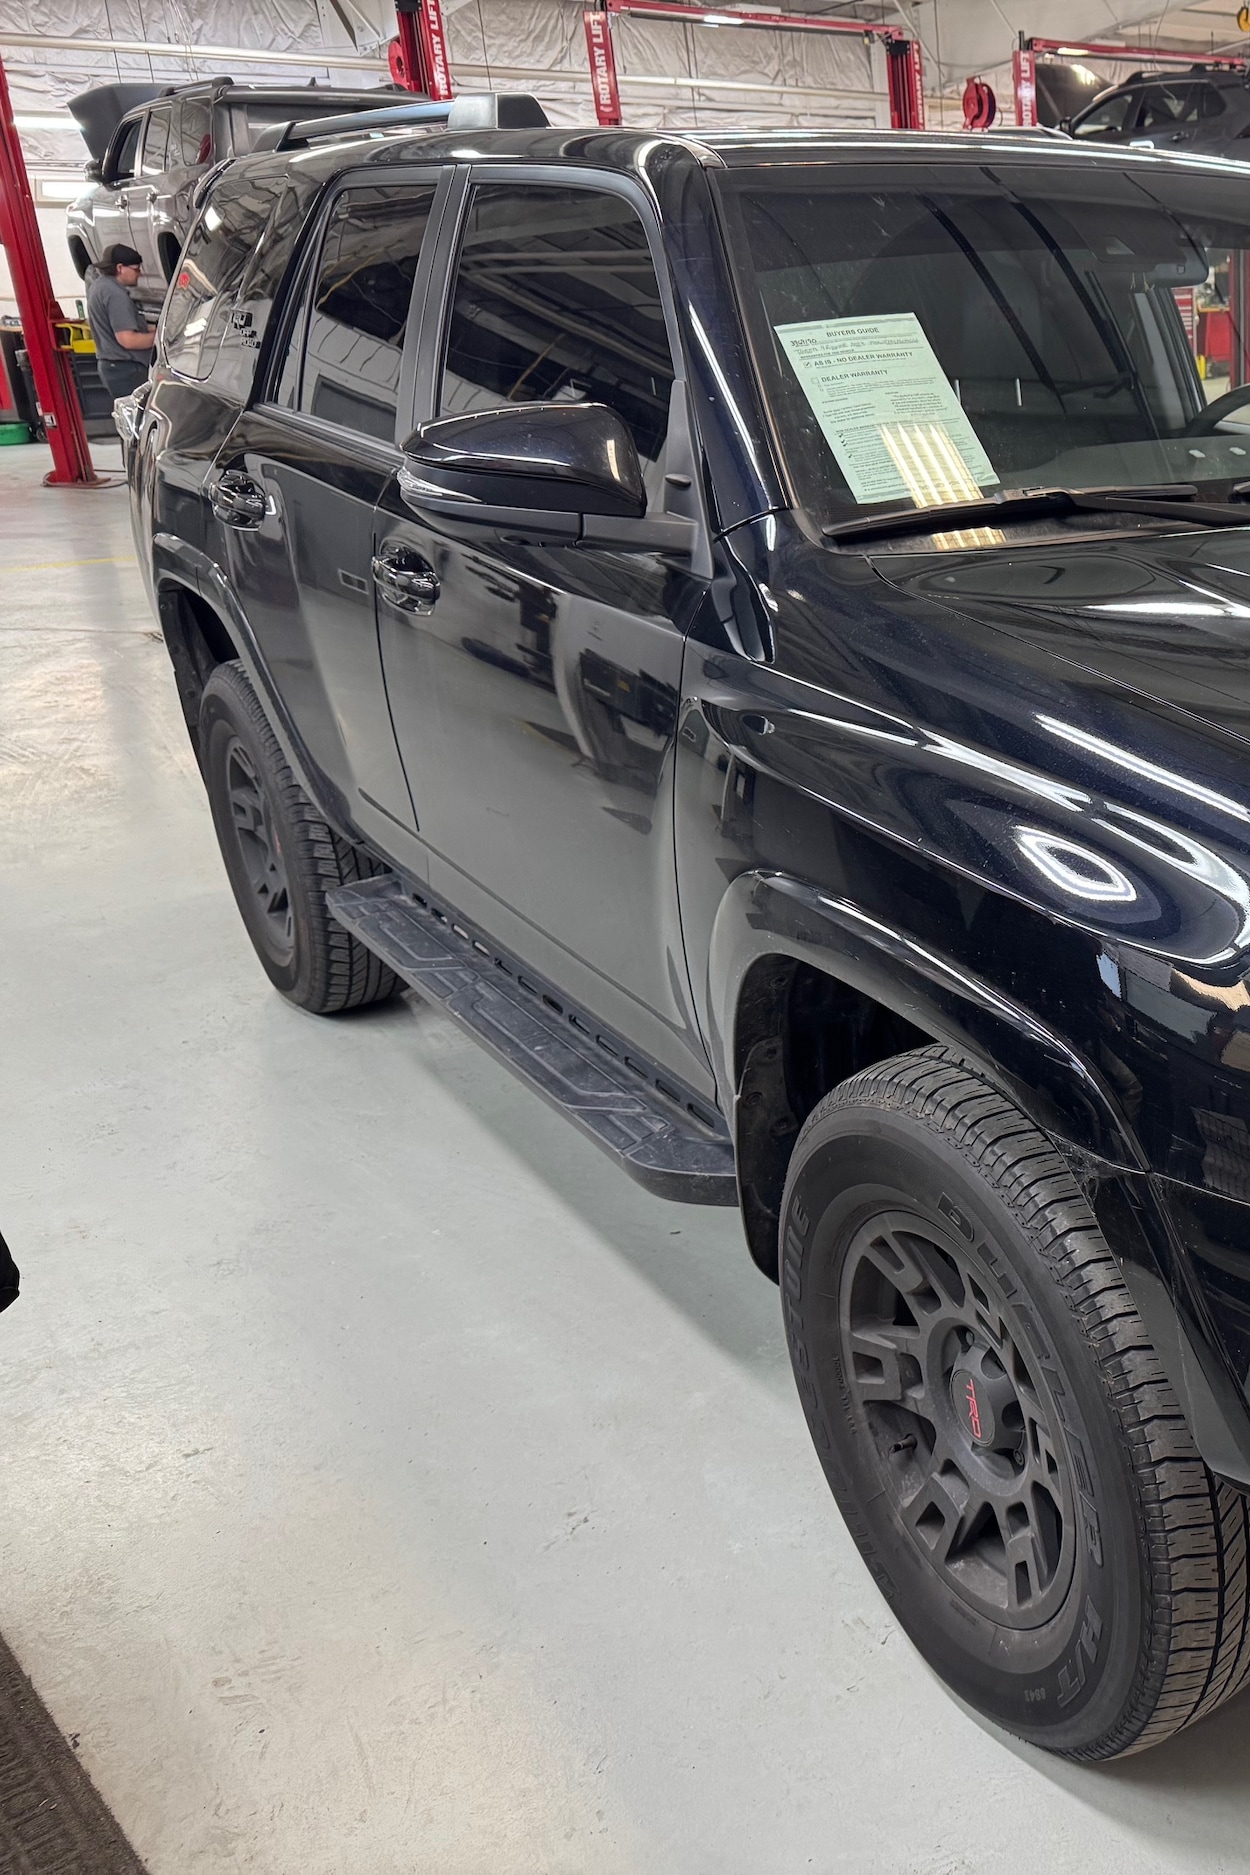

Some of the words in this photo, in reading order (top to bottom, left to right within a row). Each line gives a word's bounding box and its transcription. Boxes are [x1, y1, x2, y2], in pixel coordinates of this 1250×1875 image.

[427, 0, 439, 30] LIFT
[590, 11, 604, 43] LIFT
[432, 33, 449, 95] ROTARY
[594, 46, 611, 105] ROTARY
[1020, 51, 1030, 77] LIFT
[826, 329, 856, 338] BUYERS
[857, 327, 880, 335] GUIDE
[848, 353, 875, 362] DEALER
[876, 351, 913, 360] WARRANTY
[821, 372, 850, 382] DEALER
[850, 369, 888, 379] WARRANTY
[965, 1378, 982, 1439] TRD
[937, 1191, 1105, 1568] DUELER
[1057, 1595, 1103, 1709] H/T
